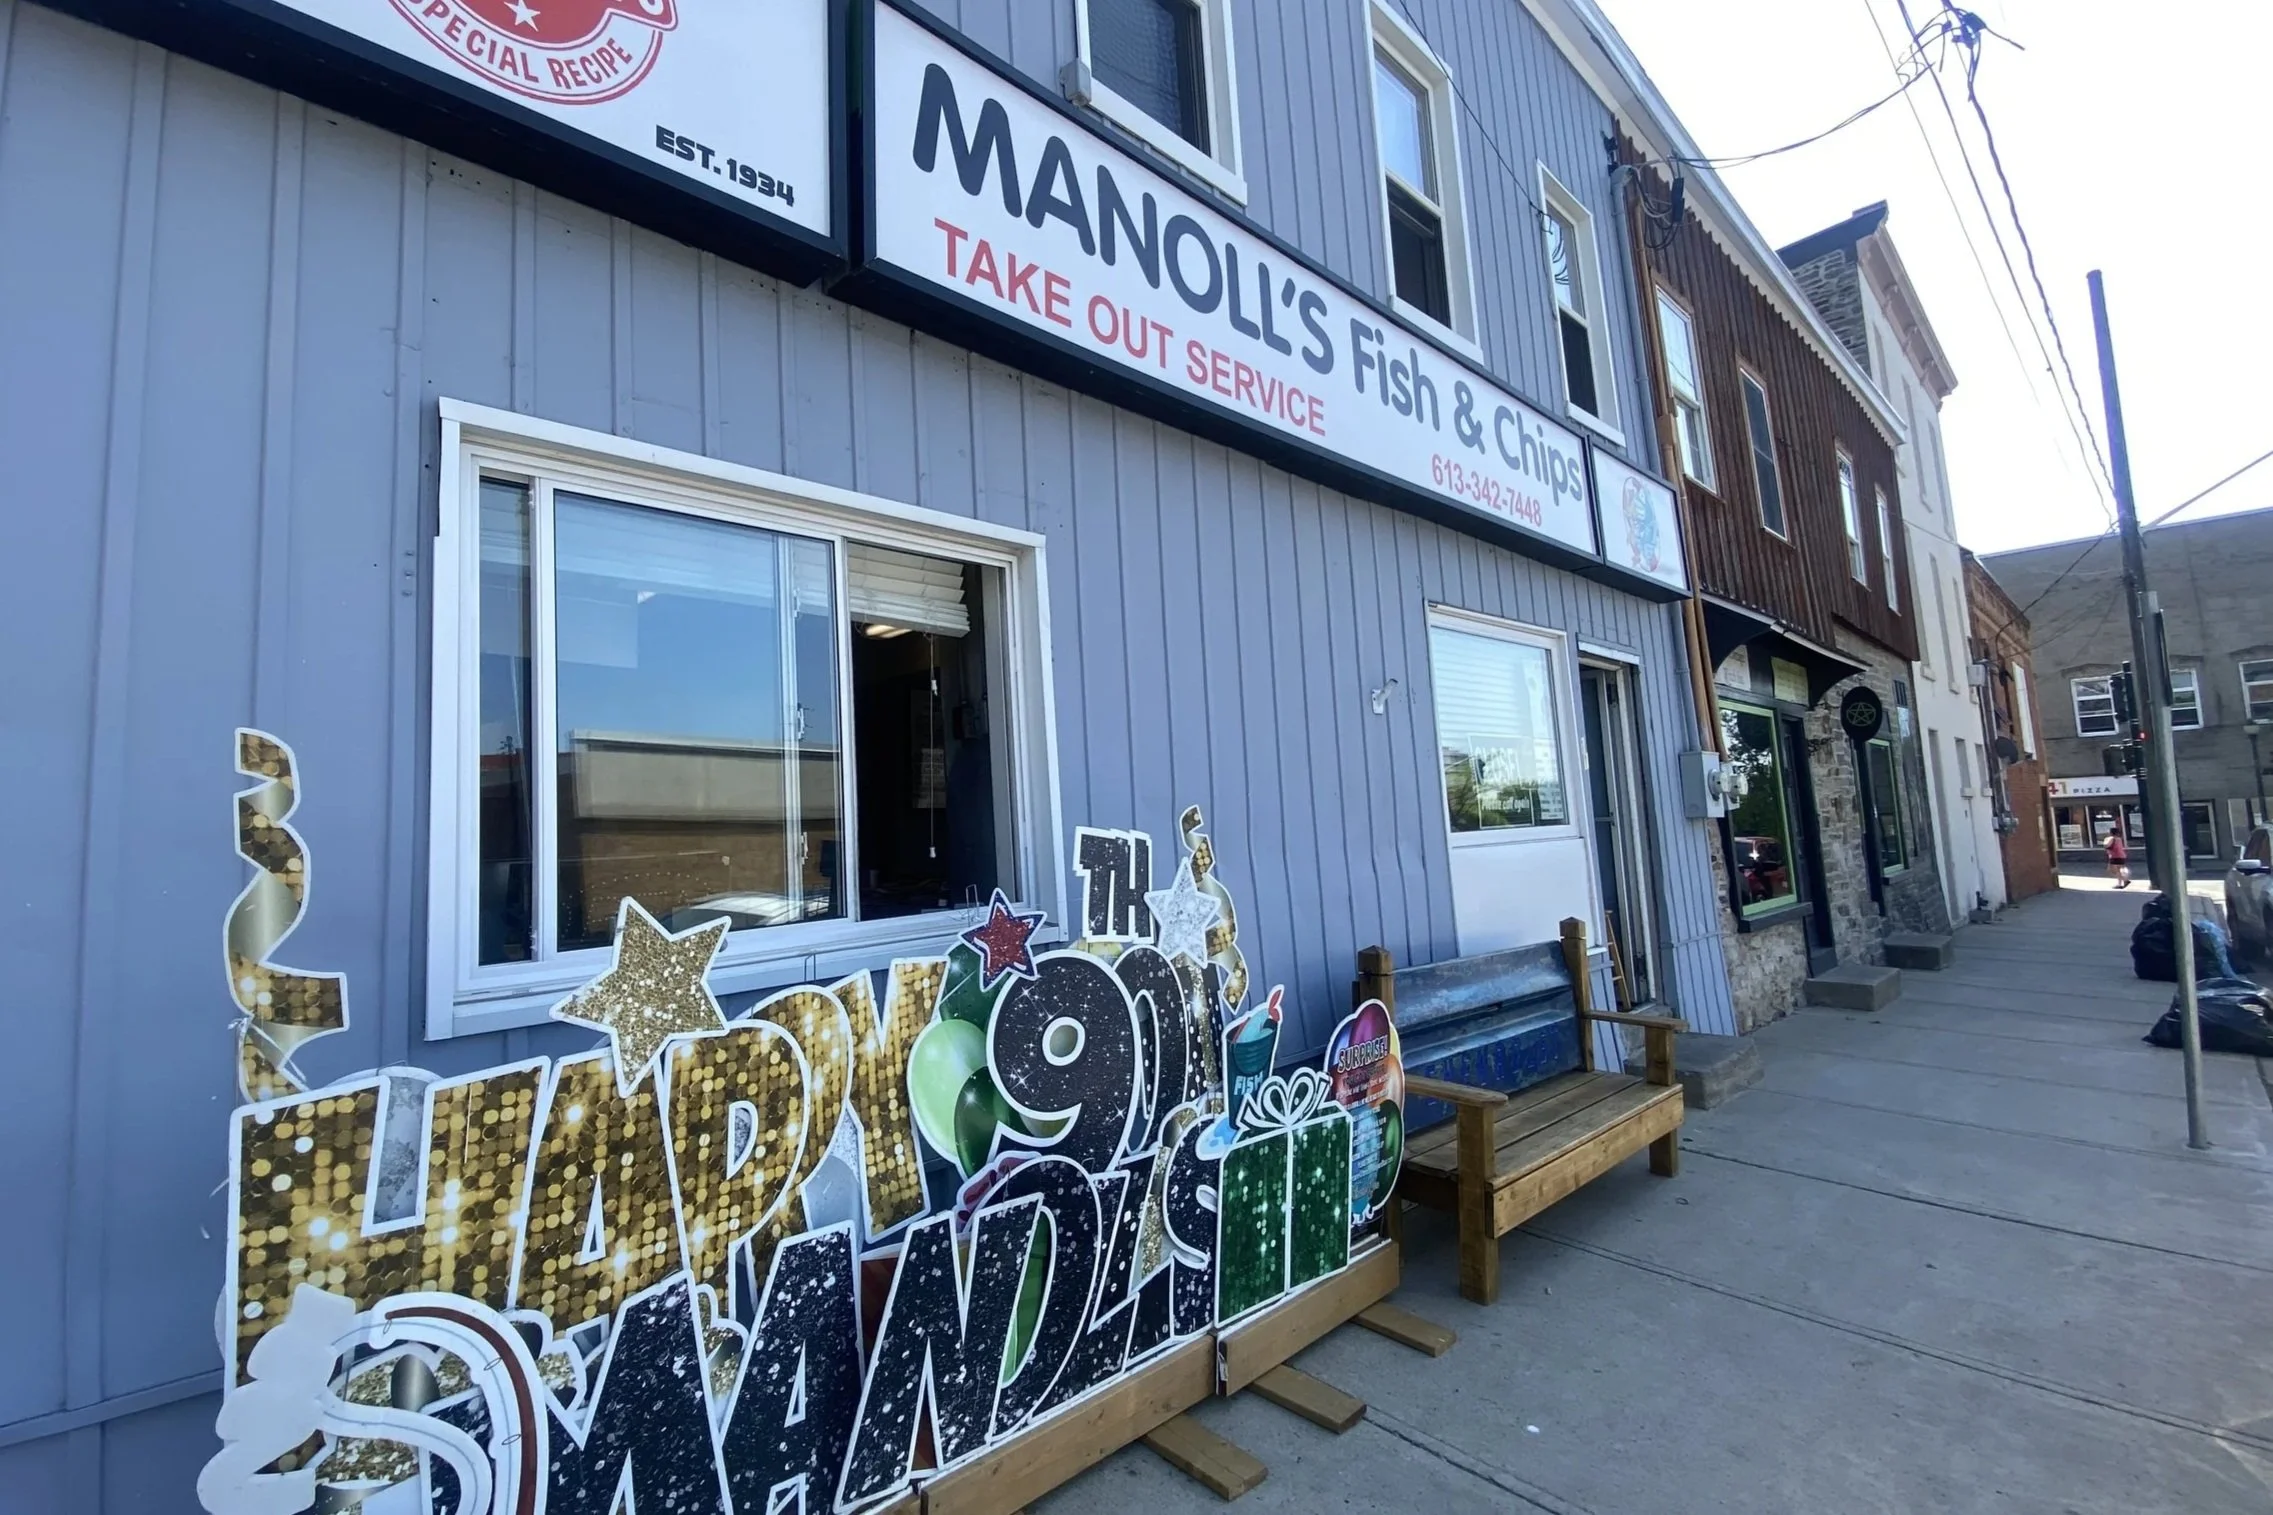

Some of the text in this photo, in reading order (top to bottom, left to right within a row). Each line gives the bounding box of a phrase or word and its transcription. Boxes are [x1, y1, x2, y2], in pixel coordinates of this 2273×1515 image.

[409, 0, 633, 89] PECIAL RECIPE
[655, 125, 795, 206] EST. 1934
[912, 63, 1583, 506] MANOLL'S Fish & Chips
[934, 217, 1326, 436] TAKE OUT SERVICE
[1431, 453, 1543, 527] 613-342-7448
[1234, 1071, 1263, 1096] FISH
[1337, 1034, 1388, 1073] SURPRISE!
[228, 955, 952, 1396] HAPPY
